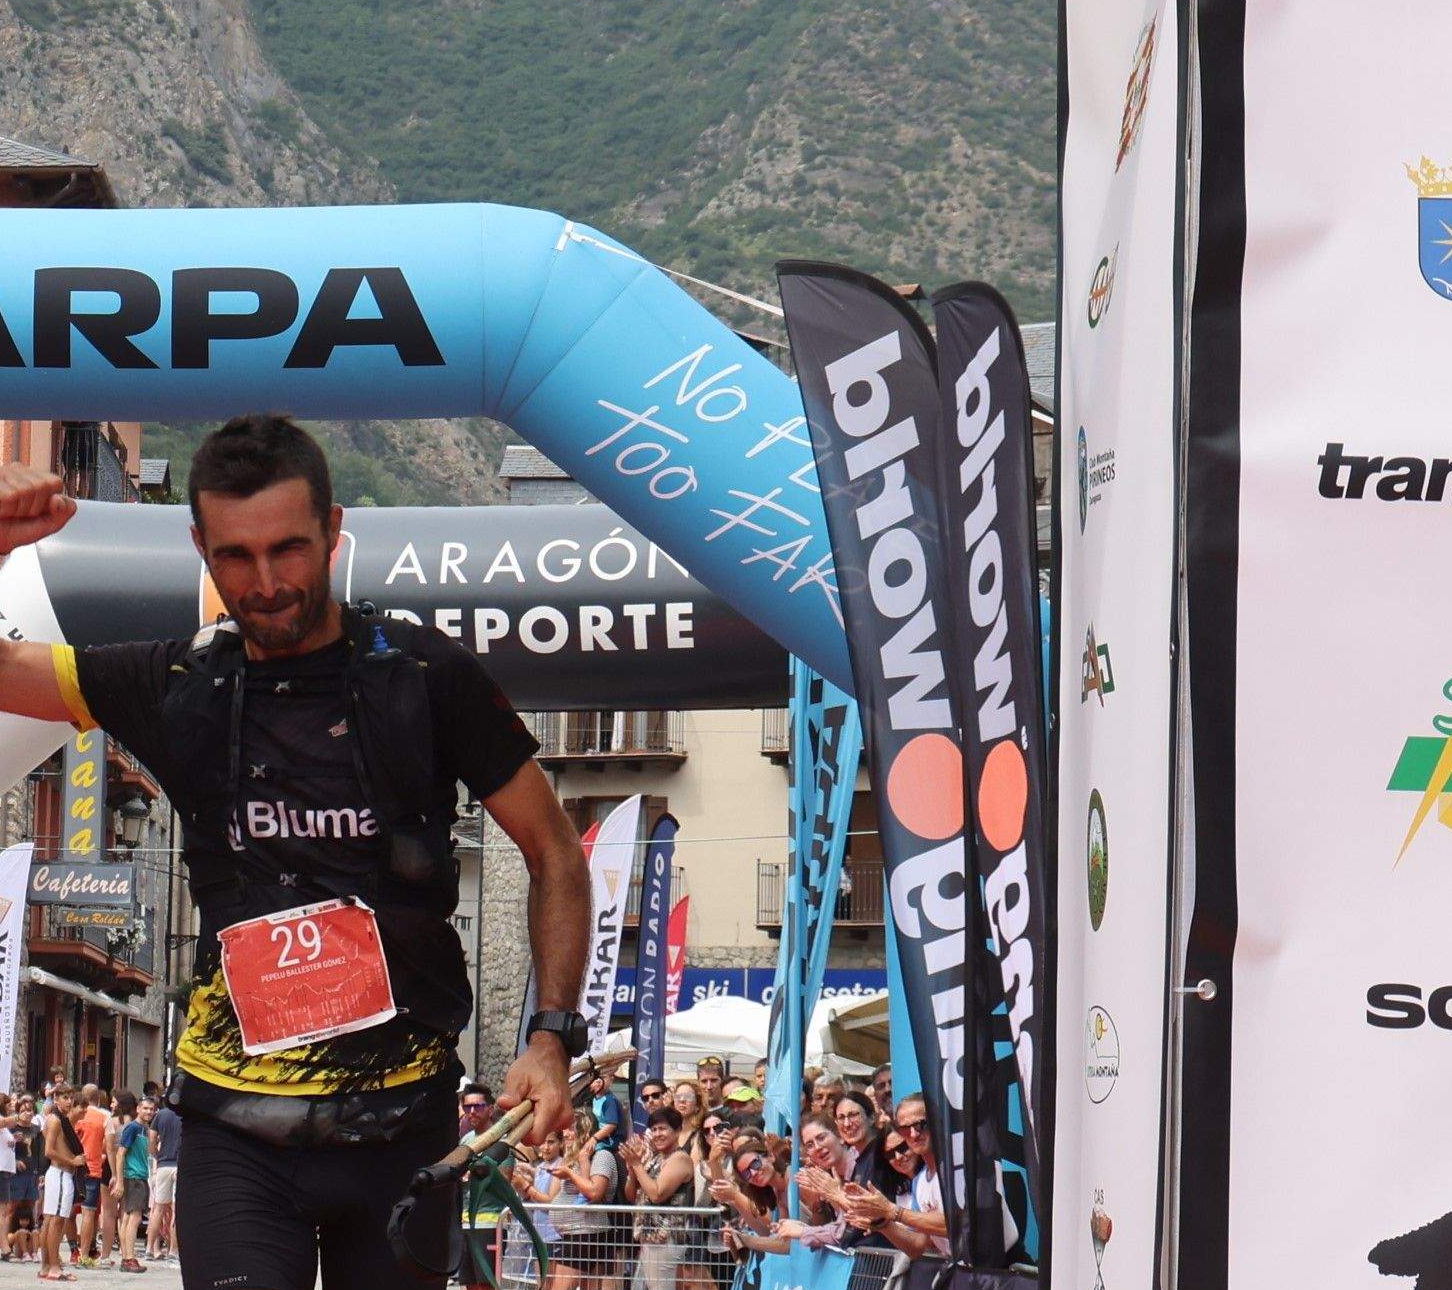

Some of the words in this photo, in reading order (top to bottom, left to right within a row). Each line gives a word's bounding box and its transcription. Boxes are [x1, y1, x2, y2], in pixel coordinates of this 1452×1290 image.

[585, 399, 698, 500] TOO
[385, 527, 690, 585] ARAGÓN
[271, 919, 323, 968] 29
[286, 963, 323, 976] BALLESTER
[692, 980, 729, 1005] ski
